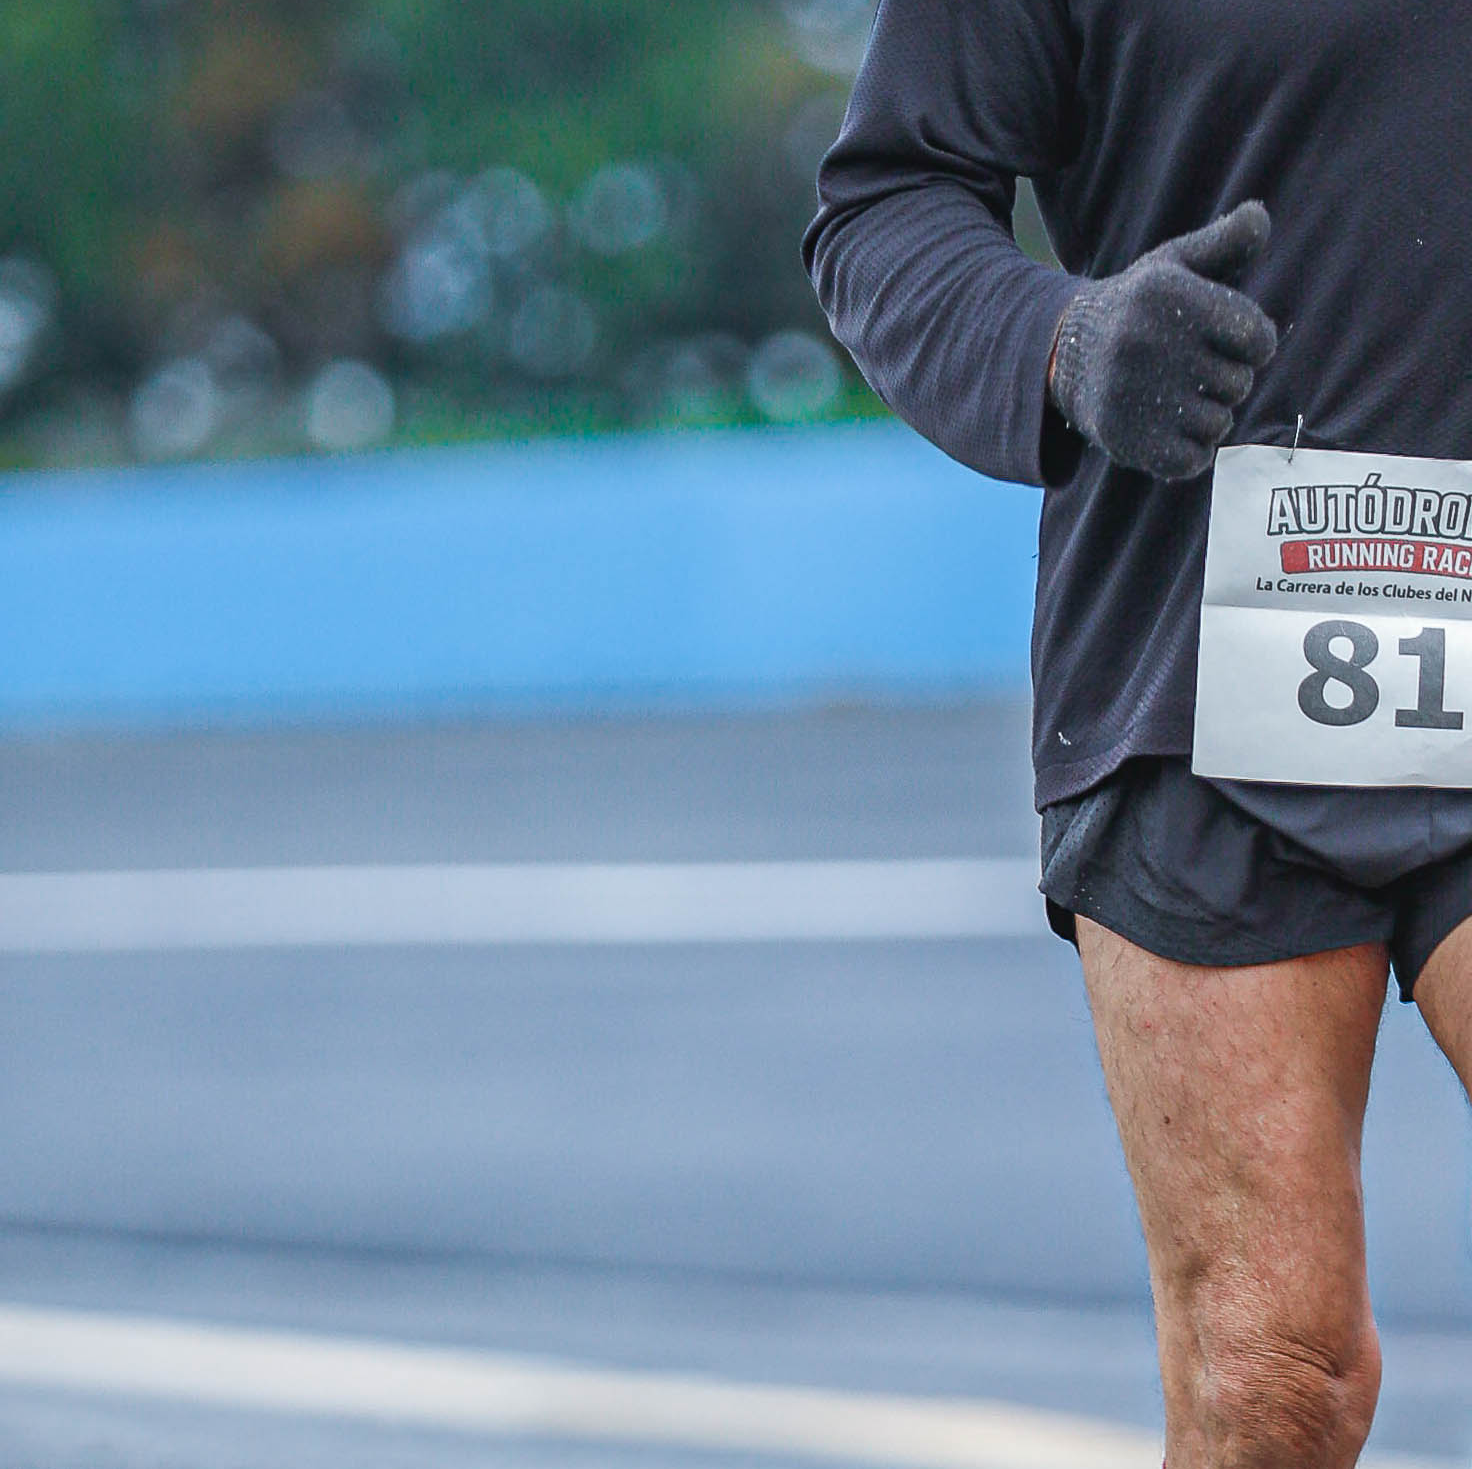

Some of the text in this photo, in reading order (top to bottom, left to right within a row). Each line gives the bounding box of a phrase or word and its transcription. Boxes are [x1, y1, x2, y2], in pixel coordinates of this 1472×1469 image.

[1307, 543, 1415, 569] RUNNING
[1256, 577, 1273, 591] La
[1277, 579, 1331, 594] Carrera
[1335, 582, 1354, 595] de
[1358, 582, 1379, 597] los
[1383, 584, 1431, 600] Clubes
[1435, 587, 1457, 602] del
[1298, 620, 1464, 731] 81
